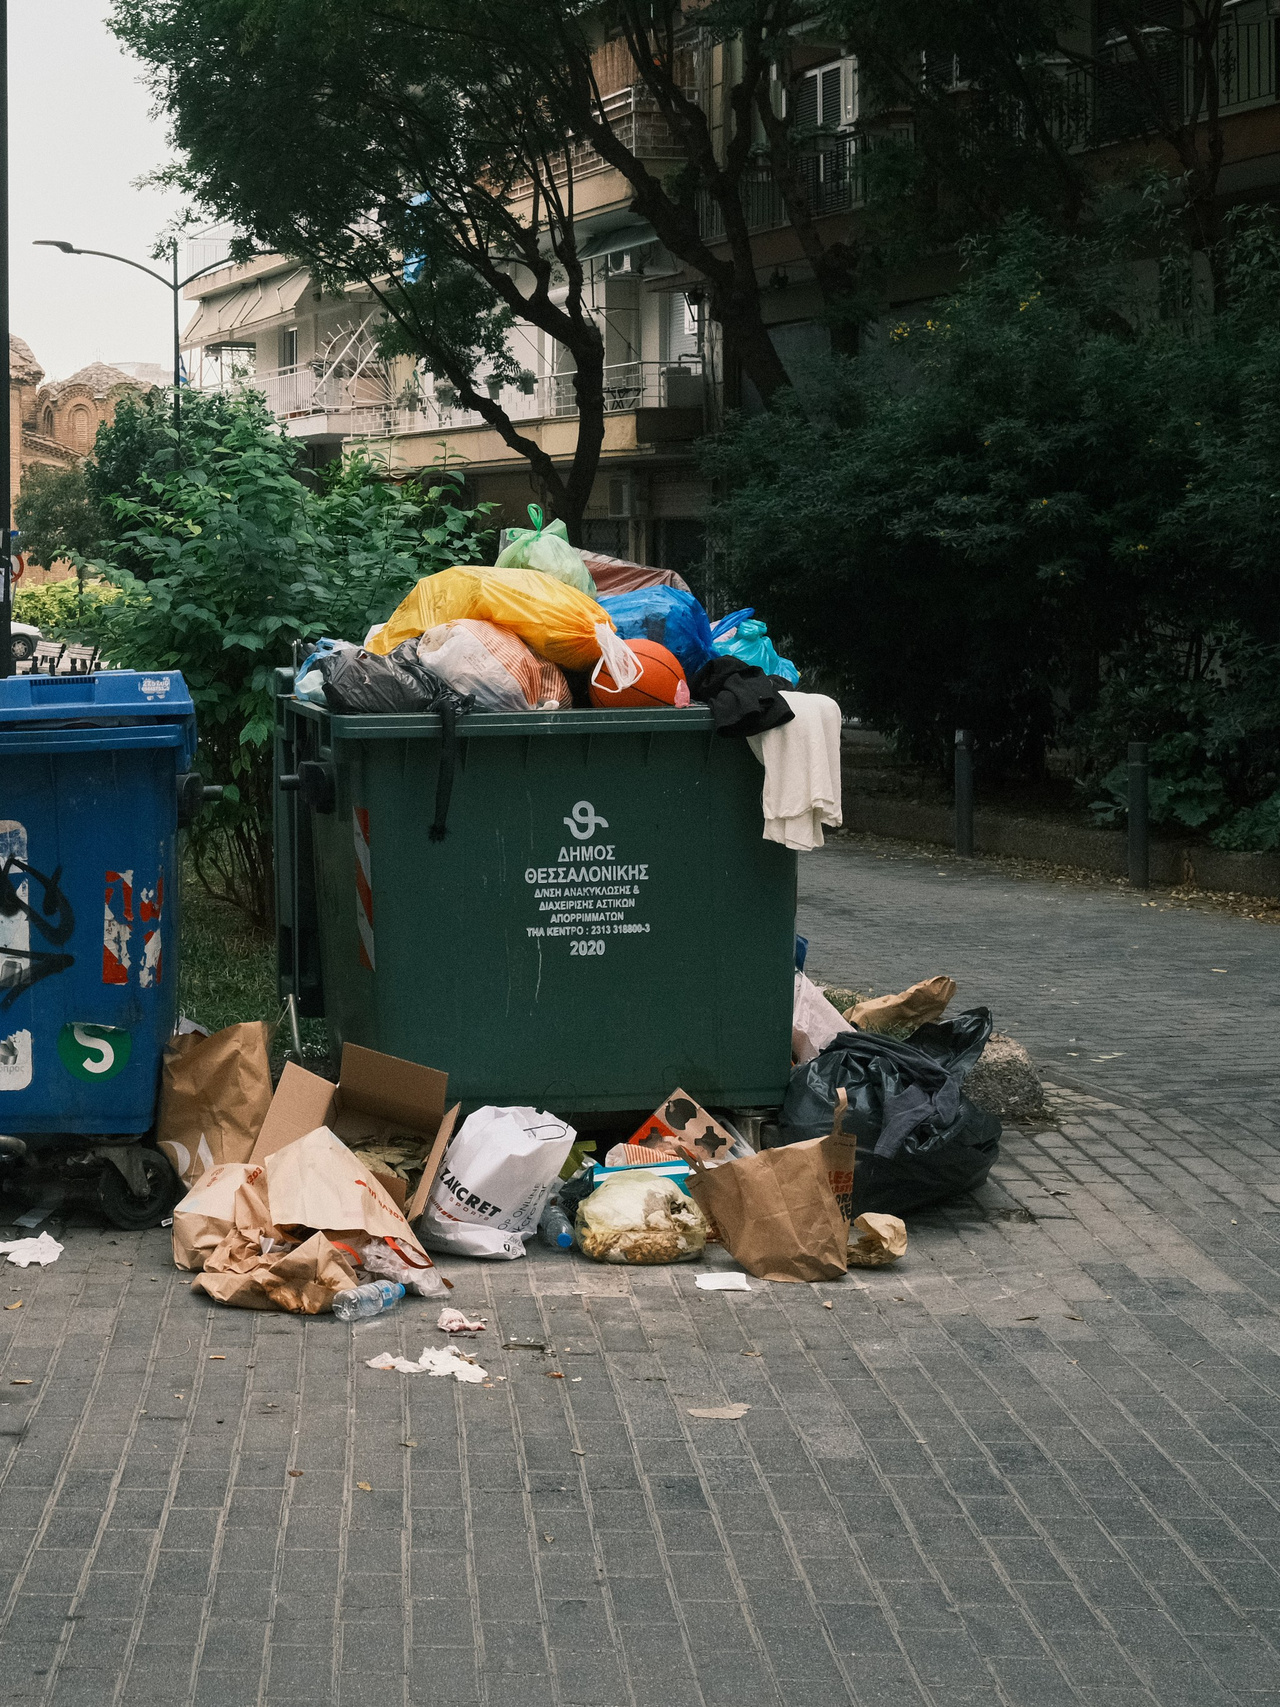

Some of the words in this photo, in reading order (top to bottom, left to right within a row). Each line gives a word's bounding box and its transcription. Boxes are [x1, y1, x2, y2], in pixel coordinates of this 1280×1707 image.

[557, 845, 616, 862] ΔΗΜΟΣ
[524, 864, 649, 884] ΘΕΣΣΑΛΟΝΙΚΗΣ
[534, 888, 562, 898] Δ/ΝΣΗ
[563, 885, 631, 897] ΑΝΑΚΥΚΛΩΣΗΣ
[632, 884, 640, 895] &
[538, 900, 594, 911] ΔΙΑΧΕΙΡΙΣΗΣ
[595, 898, 635, 909] ΑΣΤΙΚΩΝ
[550, 912, 625, 923] ΑΠΟΡΡΙΜΜΑΤΩΝ
[526, 927, 545, 937] ΤΗΛ
[546, 926, 584, 937] ΚΕΝΤΡΟ
[590, 925, 611, 935] 2313
[569, 939, 606, 956] 2020
[439, 1167, 502, 1217] ZAKCRET
